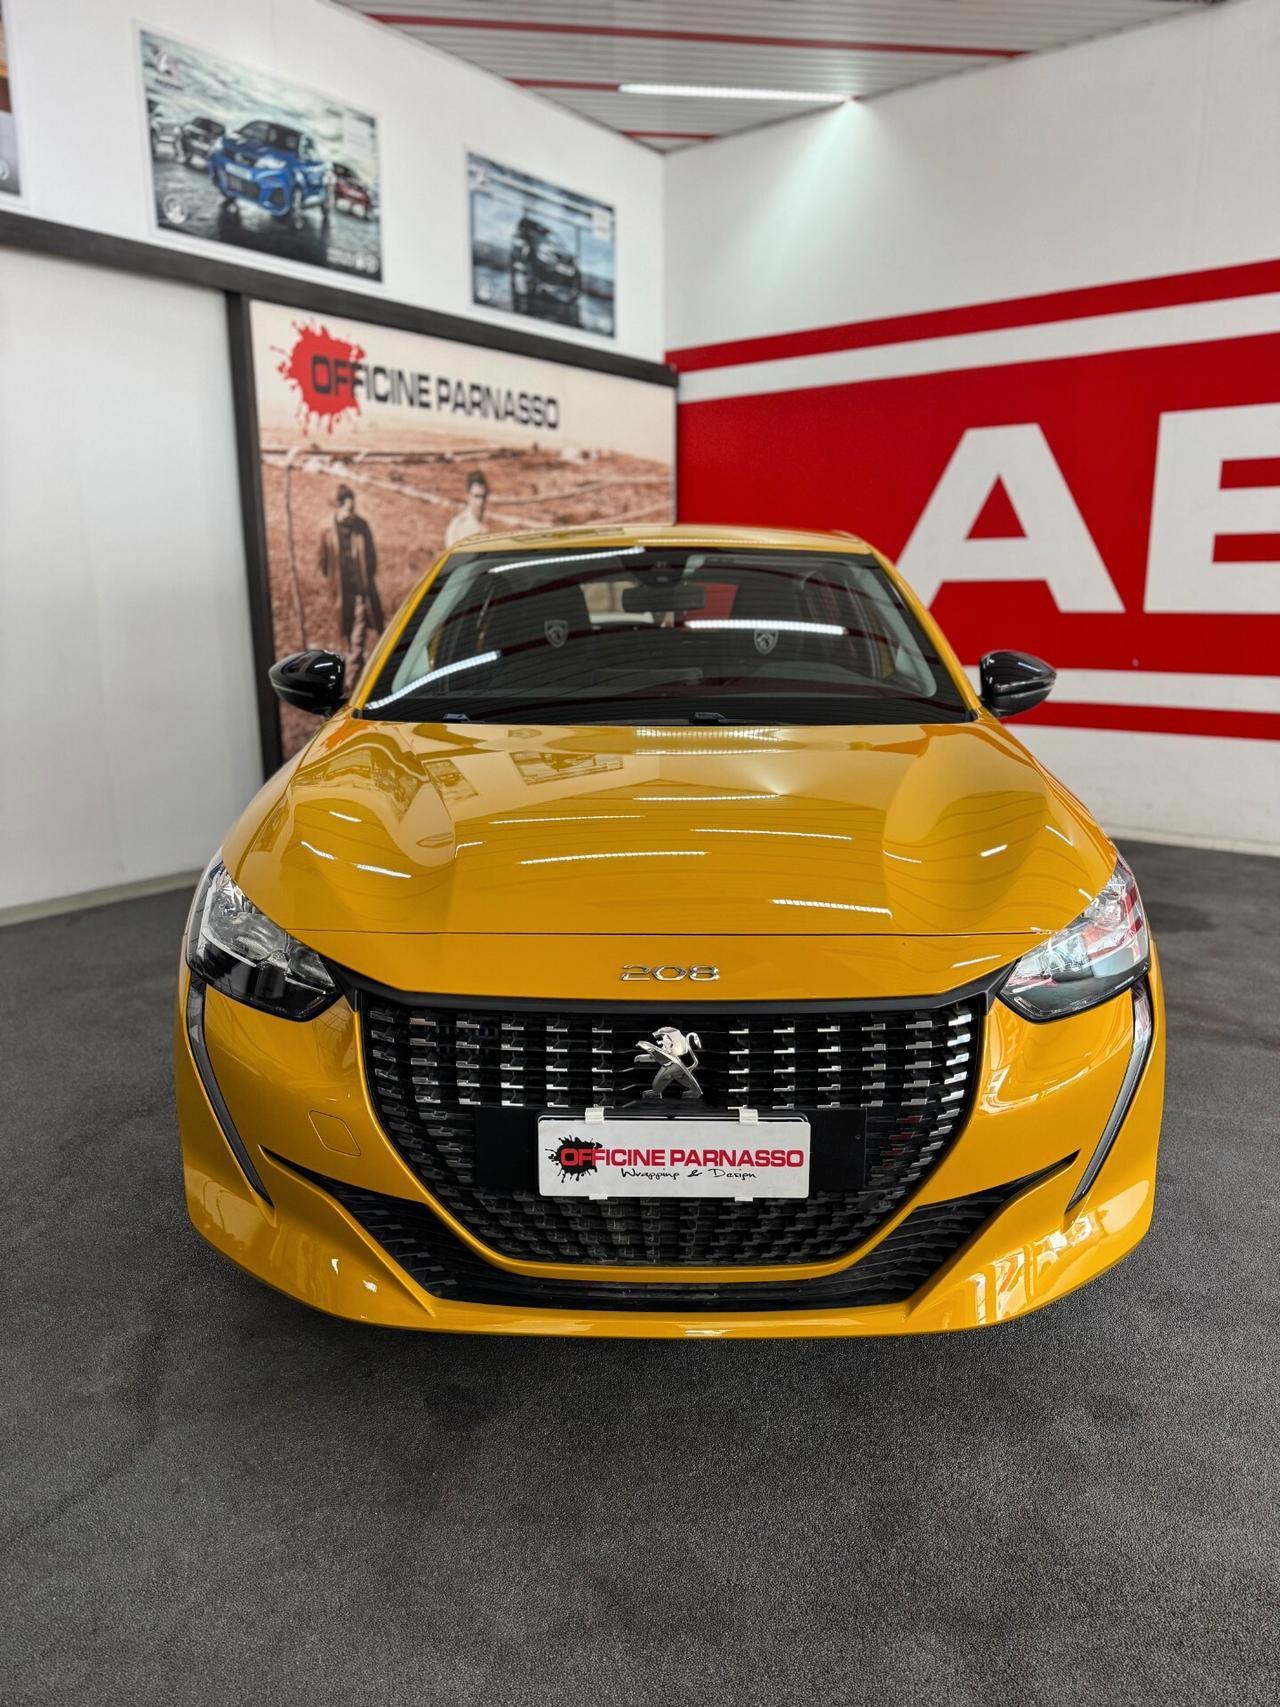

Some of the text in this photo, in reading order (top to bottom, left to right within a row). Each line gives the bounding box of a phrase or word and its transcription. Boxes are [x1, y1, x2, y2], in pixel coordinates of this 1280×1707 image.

[311, 353, 560, 430] OFFICINE PARNASSO
[620, 963, 721, 982] 208
[560, 1148, 805, 1168] OFFICINE PARNASSO
[620, 1167, 758, 1180] Wrapping & Design
